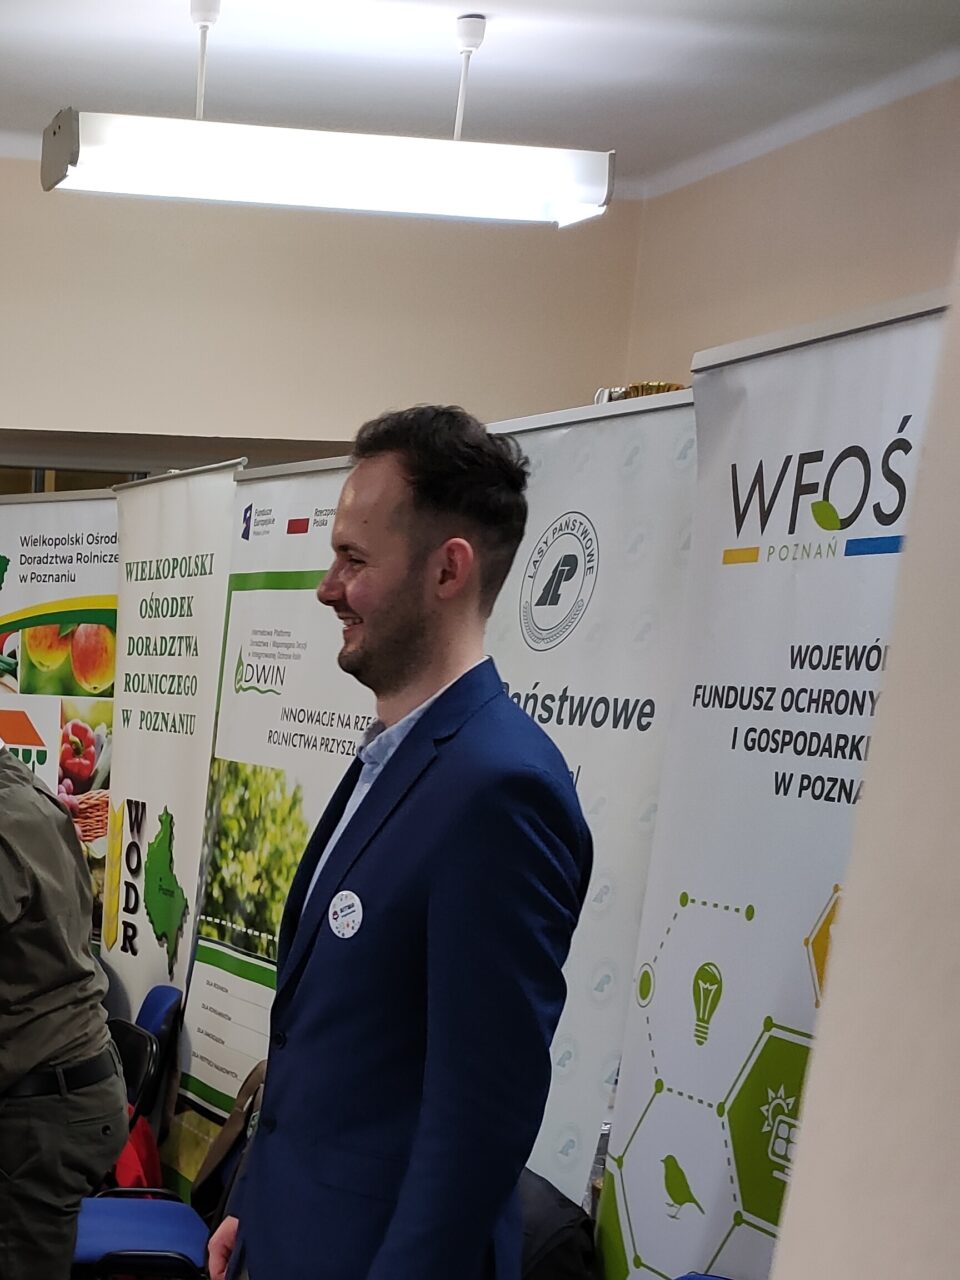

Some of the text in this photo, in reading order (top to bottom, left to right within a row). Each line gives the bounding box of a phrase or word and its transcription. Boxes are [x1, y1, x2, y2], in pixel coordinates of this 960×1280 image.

[731, 414, 913, 539] WFOŚ
[20, 532, 118, 549] Wielkopolski Ośrod
[528, 517, 596, 580] LASY PAŃSTWOWE
[767, 537, 839, 562] POZNAŃ
[20, 553, 74, 566] Doradztwa
[125, 553, 215, 582] WIELKOPOLSKI
[19, 571, 76, 584] w Poznaniu
[140, 592, 194, 619] OŚRODEK
[127, 636, 199, 657] DORADZTWA
[124, 672, 198, 696] ROLNICZEGO
[693, 685, 880, 716] FUNDUSZ OCHRONY
[122, 709, 196, 735] W POZNANIU
[280, 707, 336, 728] INNOWACJE
[337, 714, 351, 730] NA
[268, 730, 318, 751] ROLNICTWA
[731, 727, 738, 749] I
[774, 771, 794, 796] W
[121, 799, 147, 956] WODR
